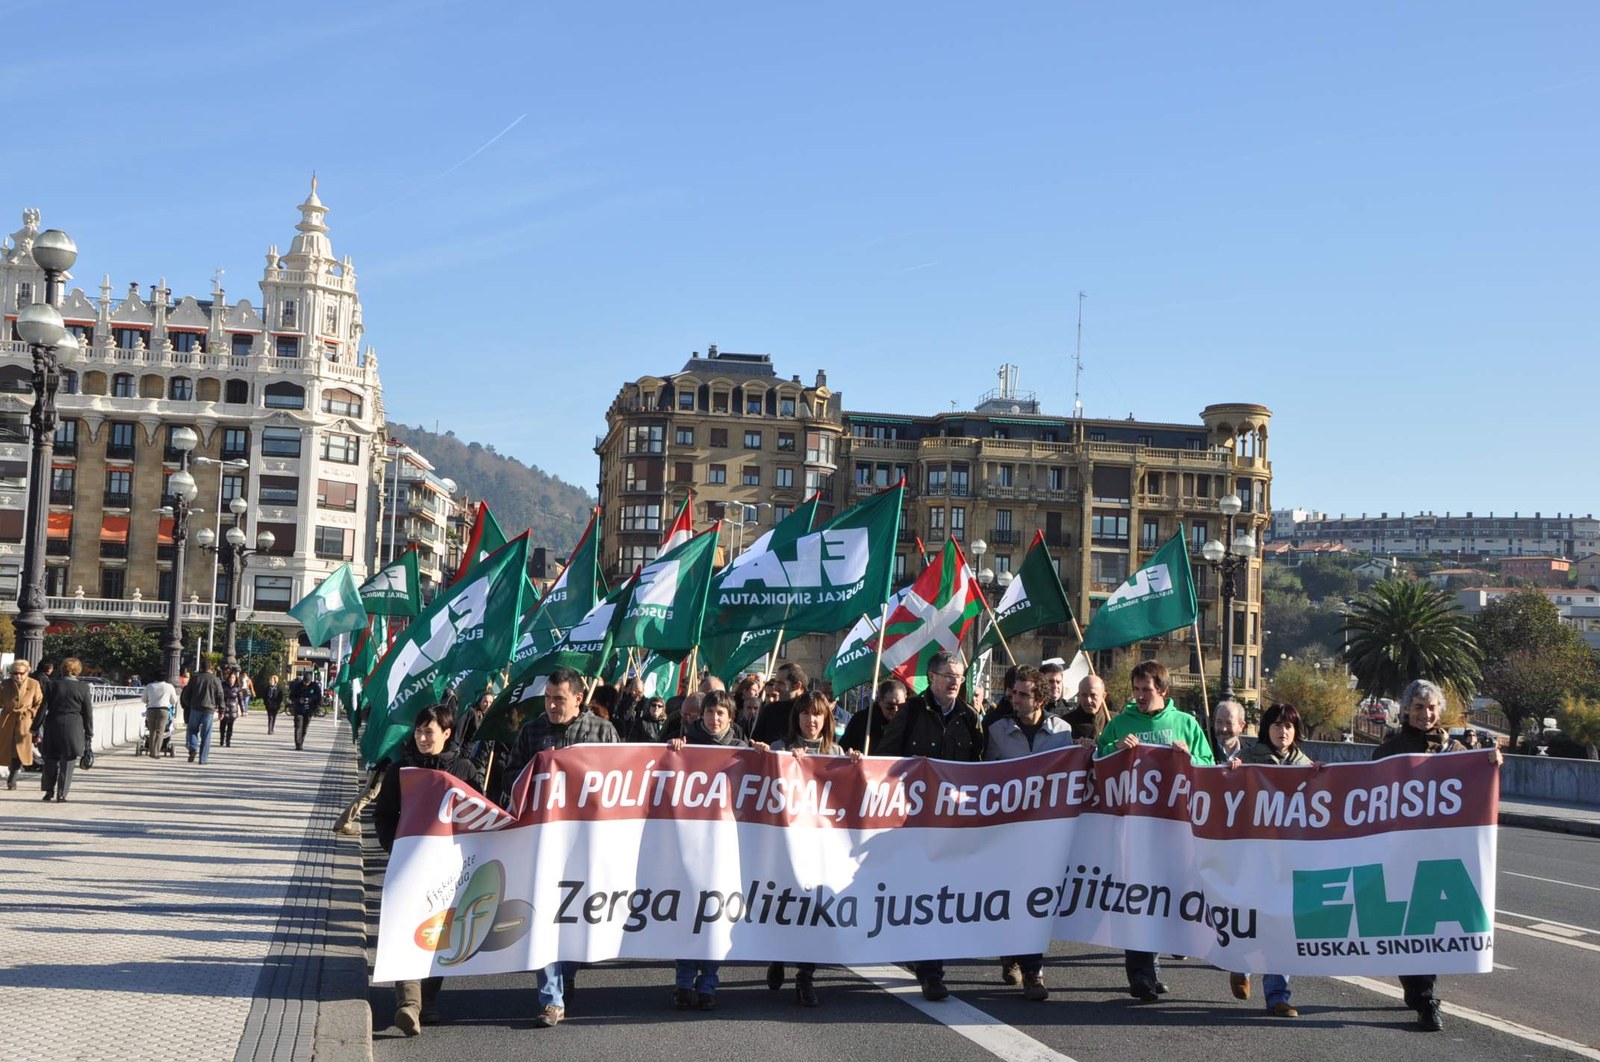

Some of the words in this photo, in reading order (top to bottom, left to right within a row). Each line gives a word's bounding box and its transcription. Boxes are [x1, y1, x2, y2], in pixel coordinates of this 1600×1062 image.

[578, 759, 728, 808] POLÍTICA
[736, 773, 846, 823] FISCAL,
[858, 772, 927, 818] MÁS
[1224, 790, 1246, 828] Y
[1253, 782, 1331, 828] MÁS
[1343, 778, 1464, 827] CRISIS
[553, 880, 678, 933] Zerga
[693, 880, 857, 935] politika
[867, 883, 1010, 939] justua
[1292, 858, 1493, 940] ELA
[1297, 941, 1371, 957] EUSKAL
[1375, 936, 1494, 956] SINDIKATUA
